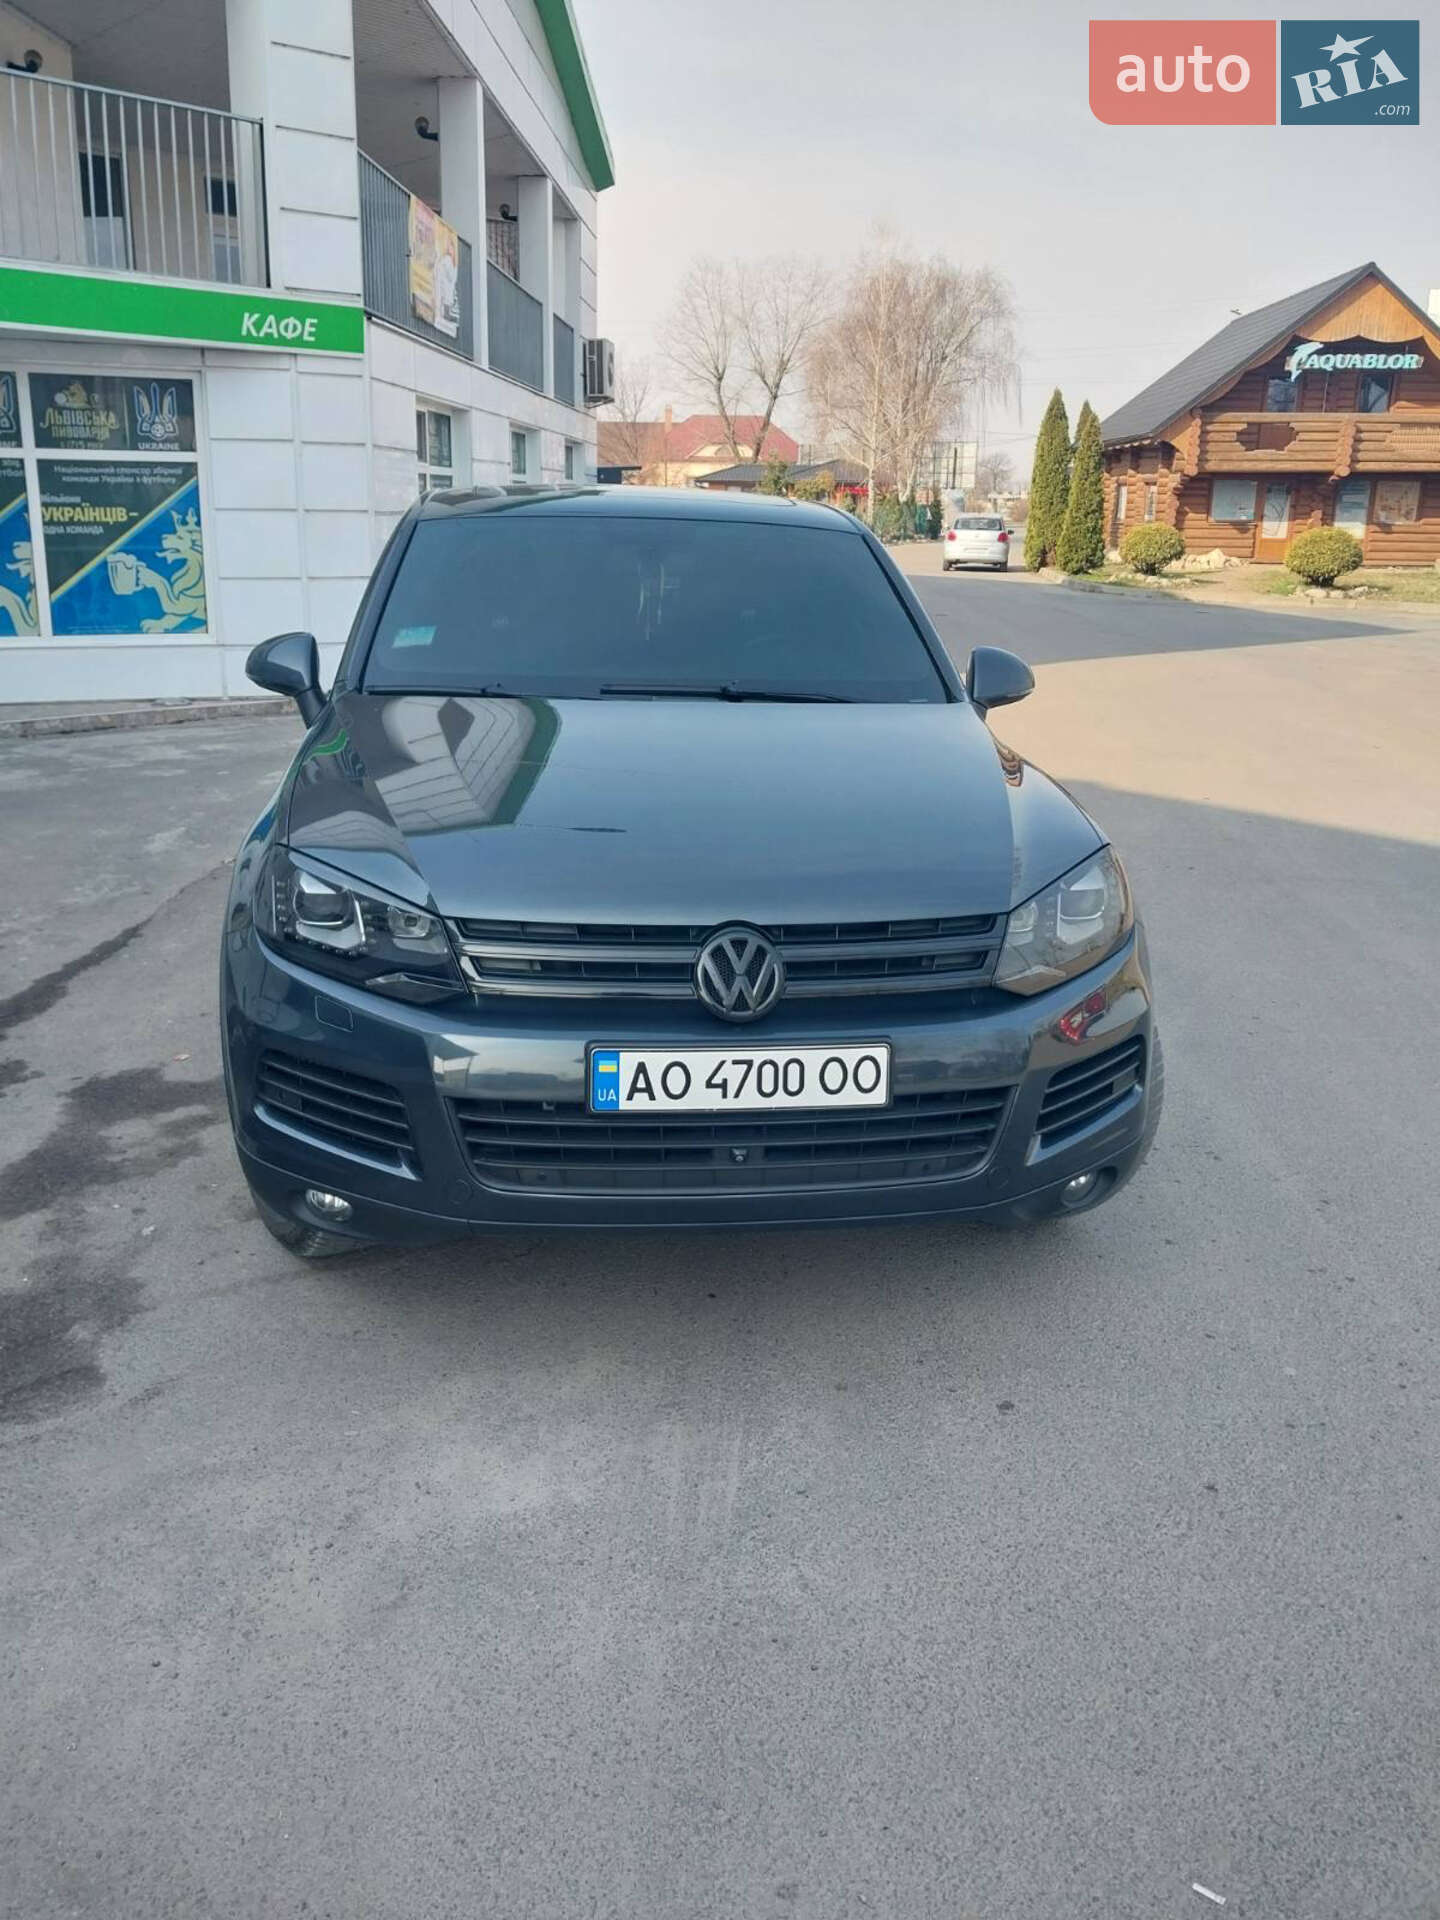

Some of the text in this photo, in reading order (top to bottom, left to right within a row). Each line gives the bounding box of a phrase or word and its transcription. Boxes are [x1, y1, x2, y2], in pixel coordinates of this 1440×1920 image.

[241, 312, 318, 342] КАФЕ
[1303, 353, 1420, 371] AQUABLOR
[137, 442, 180, 450] UKRAINE
[626, 1055, 881, 1101] AO 4700 OO
[598, 1088, 617, 1102] UA
